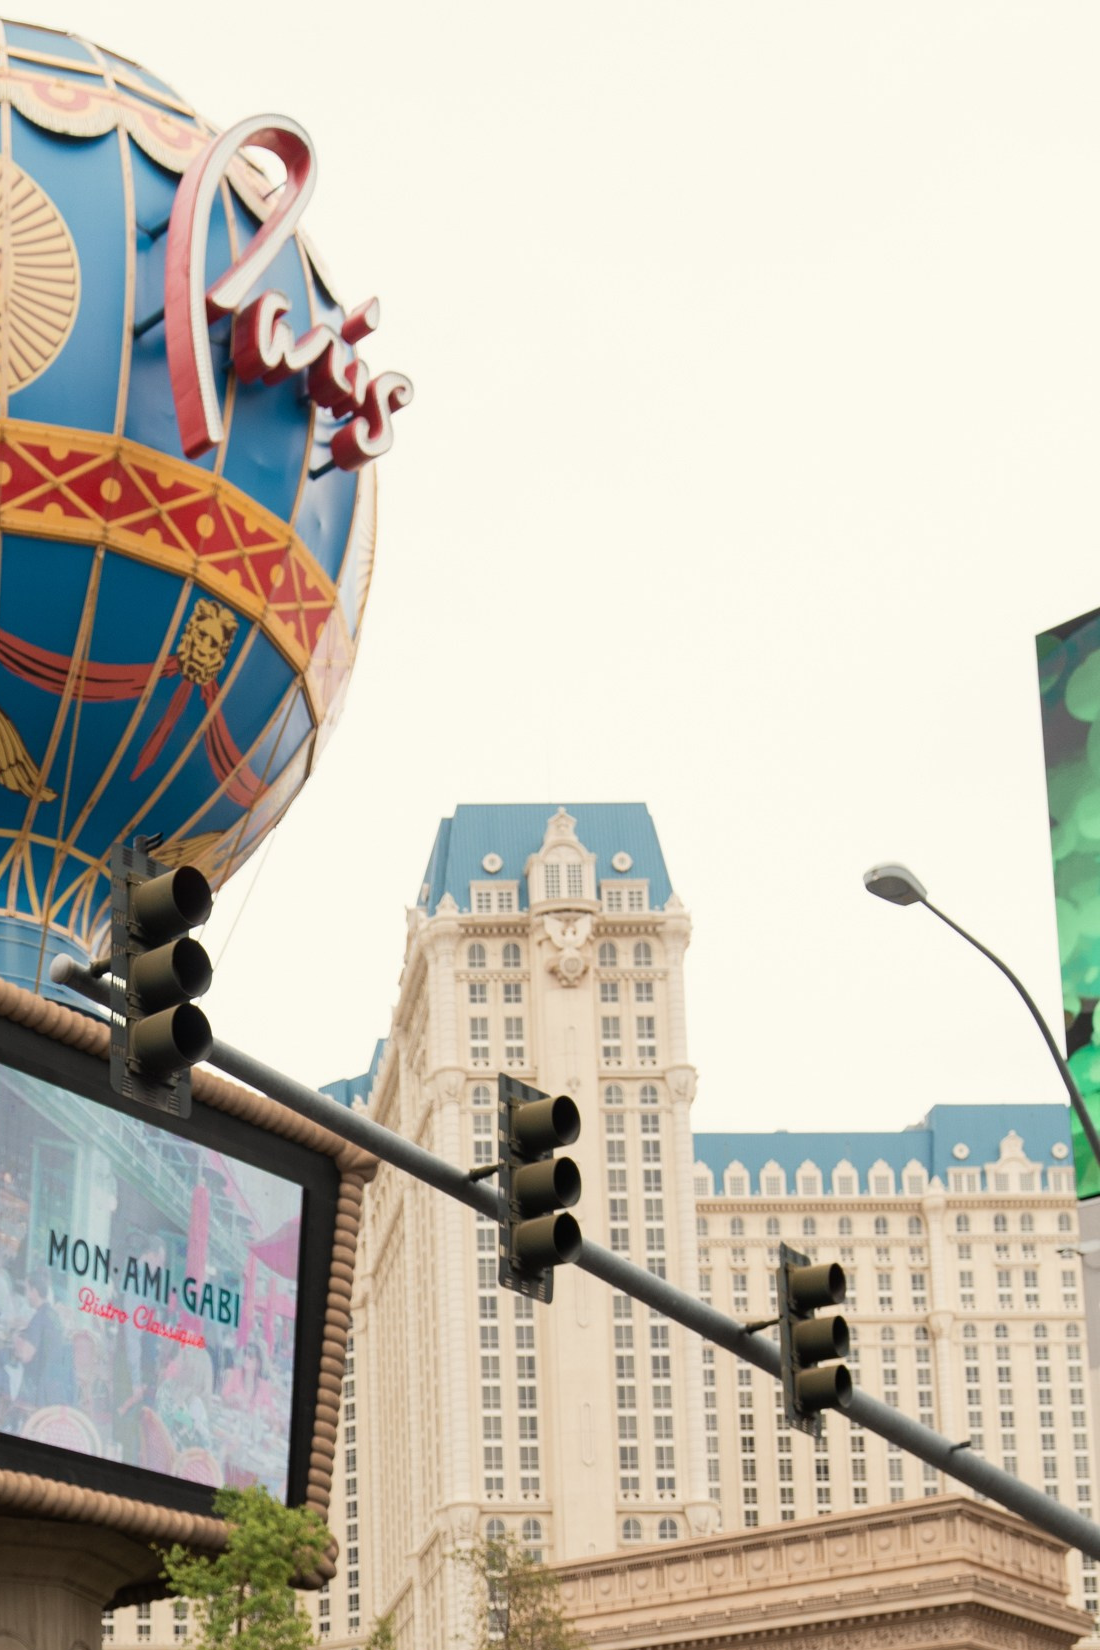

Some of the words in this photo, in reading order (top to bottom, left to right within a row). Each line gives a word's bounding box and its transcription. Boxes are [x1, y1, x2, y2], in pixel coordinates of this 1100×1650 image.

[166, 113, 414, 471] Paris
[78, 1287, 129, 1324] Bistro
[133, 1305, 207, 1349] Classique
